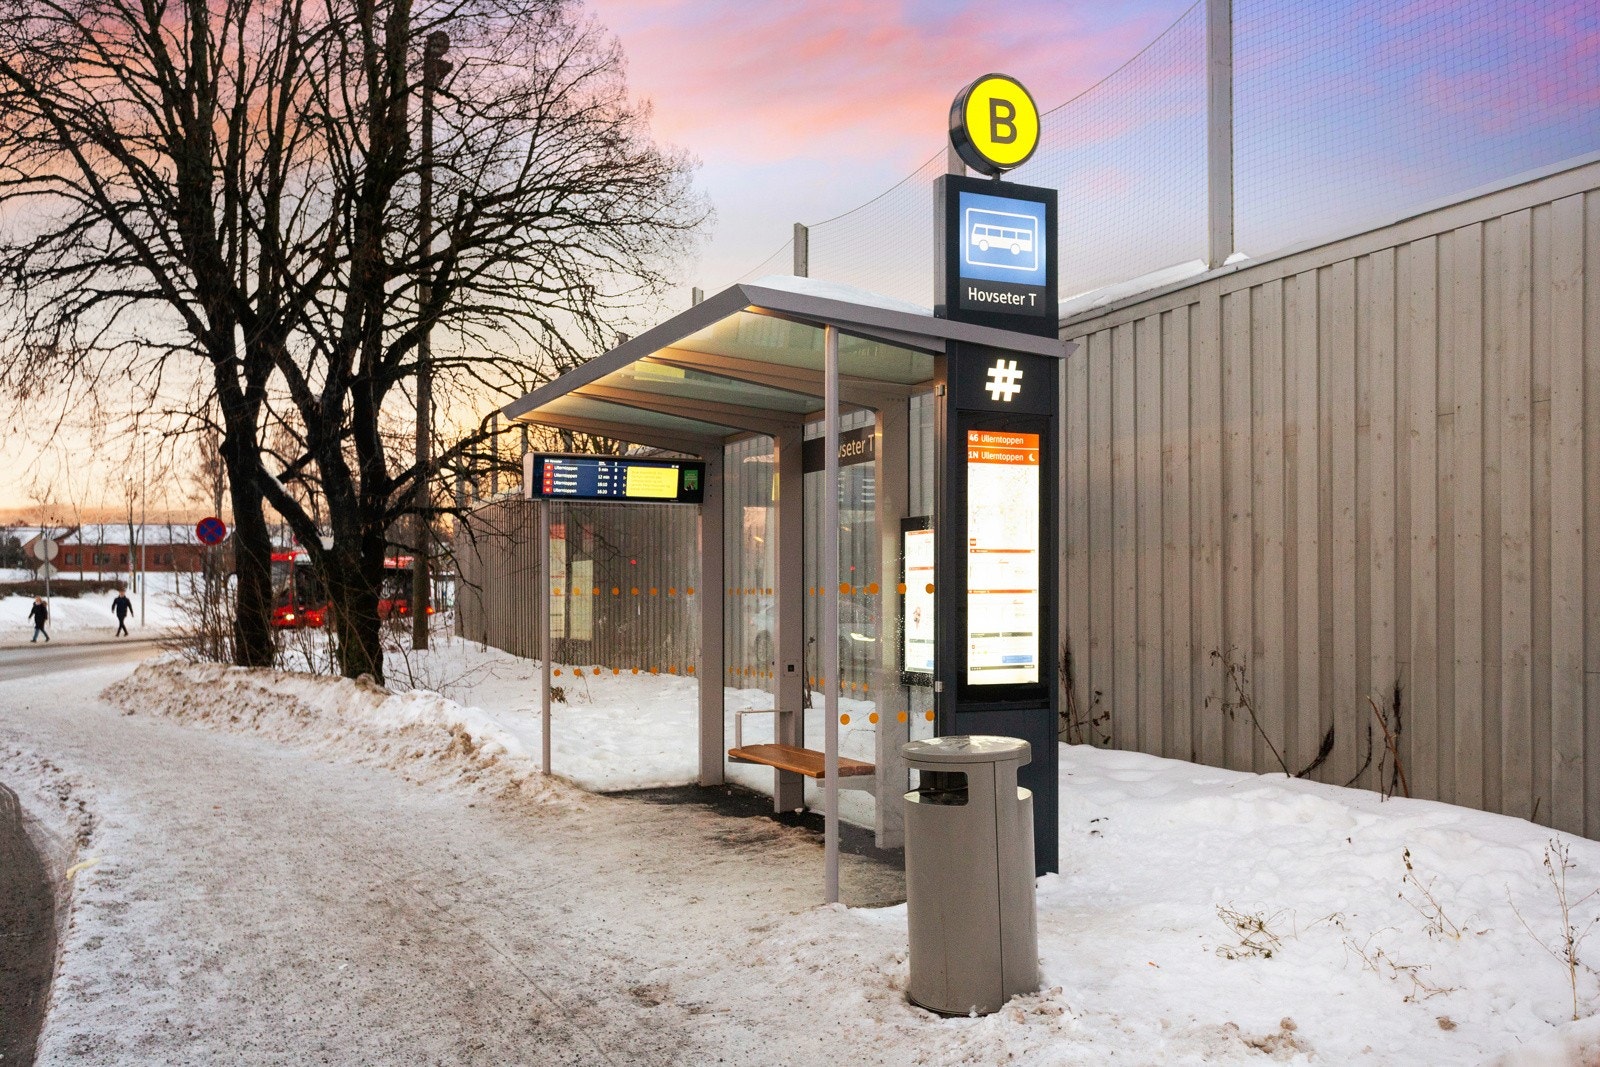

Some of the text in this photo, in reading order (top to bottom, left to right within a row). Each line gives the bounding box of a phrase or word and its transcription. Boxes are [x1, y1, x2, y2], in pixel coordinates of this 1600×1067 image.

[989, 97, 1017, 144] B
[968, 286, 1037, 307] Hovseter T
[868, 434, 874, 452] T
[969, 433, 1024, 445] 46 Ullerntoppen
[981, 451, 1024, 462] Ullerntoppen
